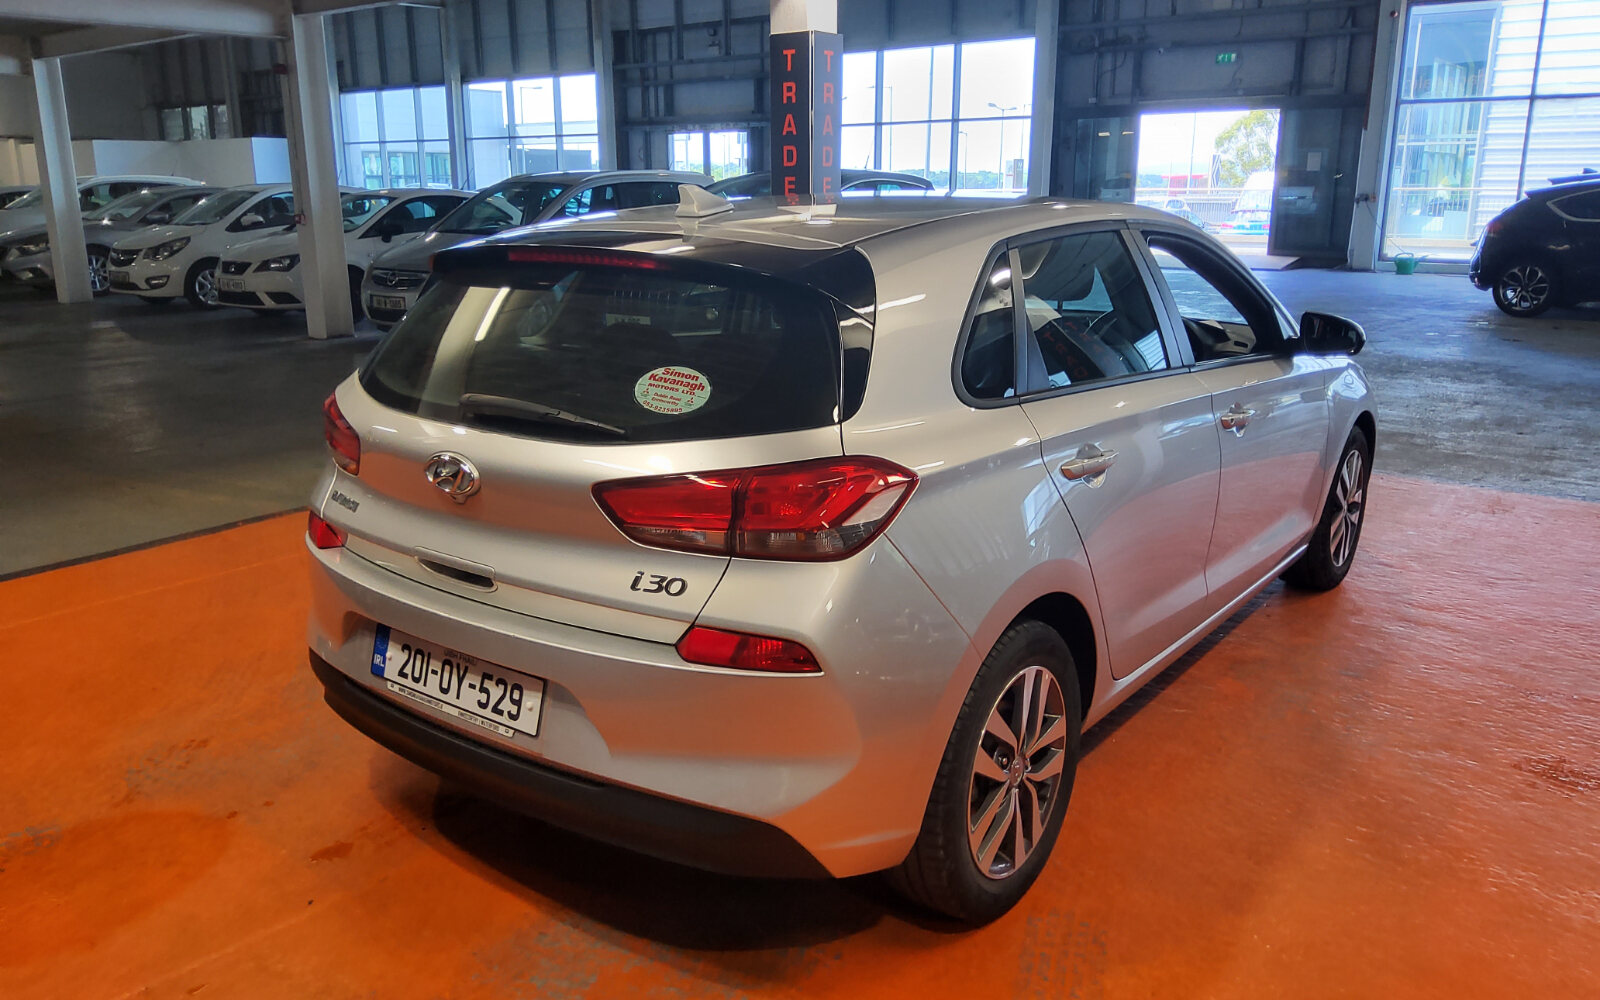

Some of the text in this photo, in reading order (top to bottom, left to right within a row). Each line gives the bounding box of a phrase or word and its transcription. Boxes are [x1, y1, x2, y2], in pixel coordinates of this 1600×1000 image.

[782, 49, 798, 198] TRADE
[648, 373, 705, 392] Kavanagh
[662, 367, 700, 381] Simon
[648, 383, 697, 397] MOTORS LTD.
[630, 570, 688, 597] i30
[373, 653, 385, 668] IRL
[397, 643, 524, 722] 201-OY-529
